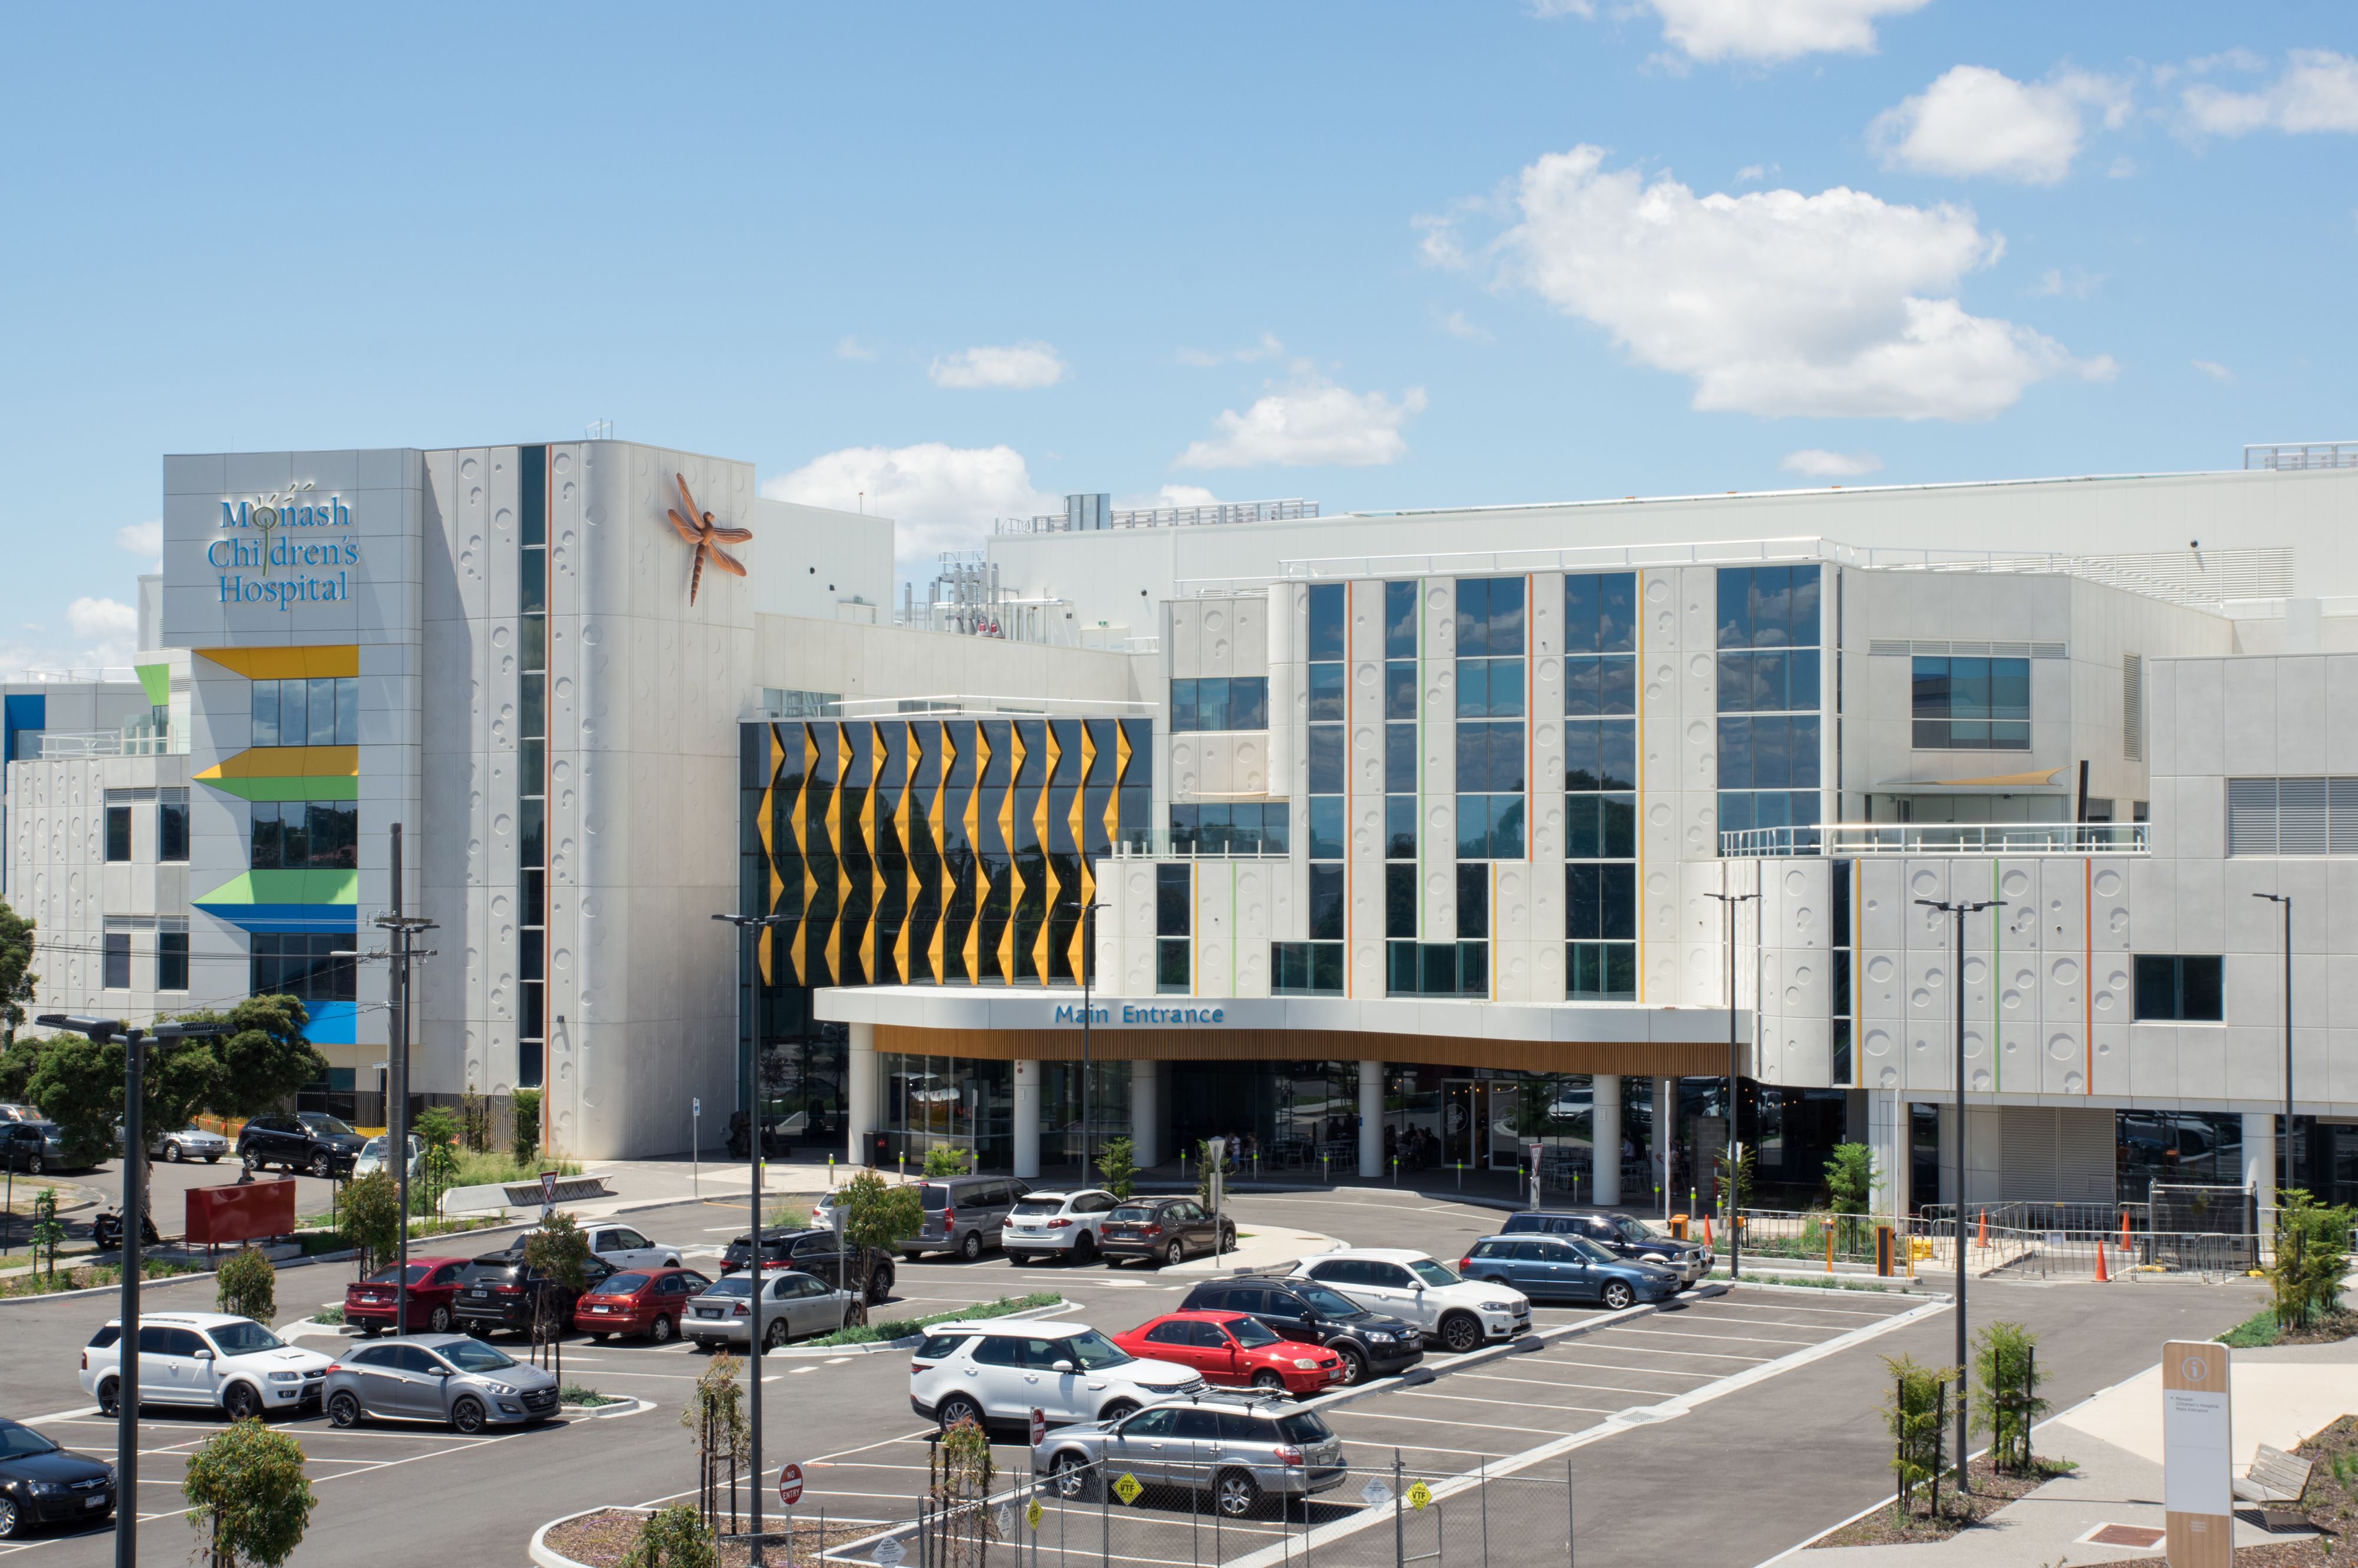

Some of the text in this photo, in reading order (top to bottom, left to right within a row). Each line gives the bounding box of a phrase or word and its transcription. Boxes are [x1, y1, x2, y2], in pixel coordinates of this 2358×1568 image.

[220, 495, 352, 531] Monash
[218, 571, 350, 612] Hospital
[1055, 1004, 1224, 1024] Main Entrance
[787, 1471, 795, 1480] NO
[783, 1488, 800, 1500] ENTRY
[1120, 1483, 1135, 1493] VTF
[1412, 1491, 1425, 1500] VTF
